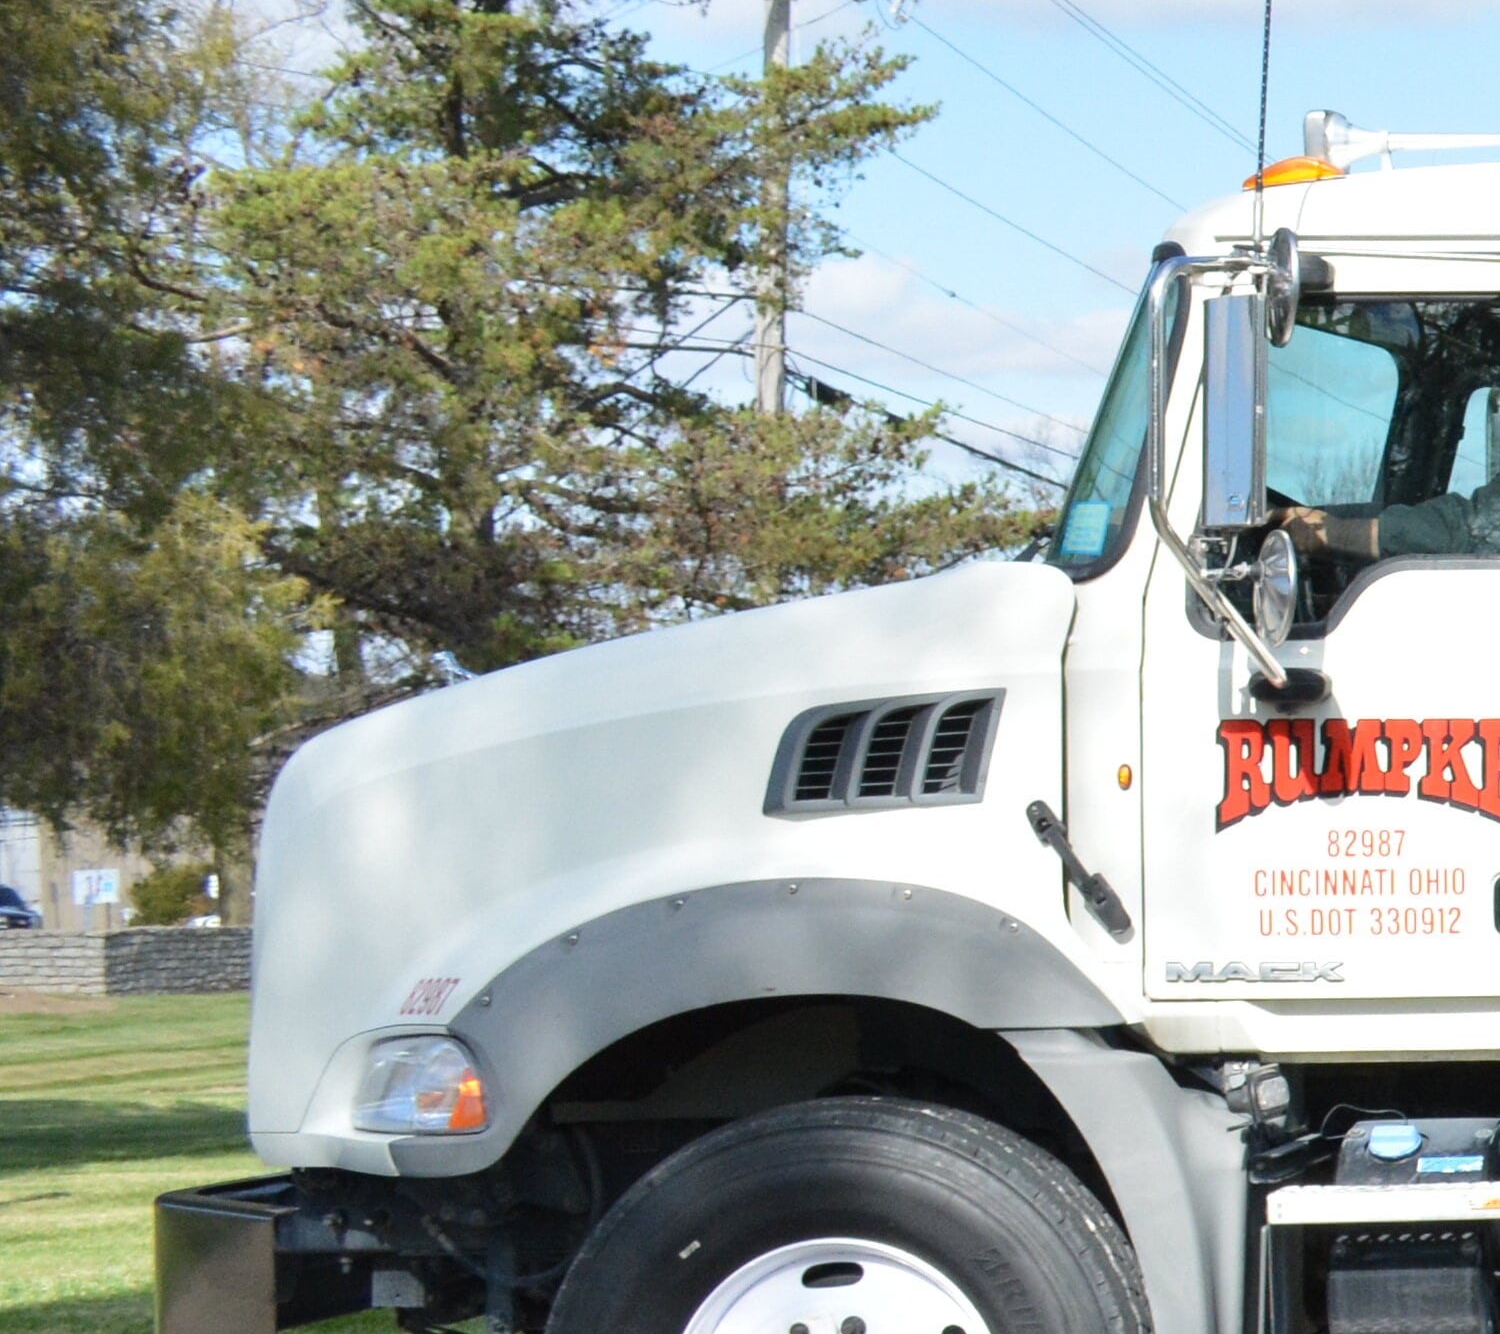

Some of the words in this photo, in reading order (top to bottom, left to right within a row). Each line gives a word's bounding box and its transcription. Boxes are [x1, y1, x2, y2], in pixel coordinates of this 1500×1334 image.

[1327, 829, 1406, 857] 82987
[1254, 868, 1395, 897] CINCINNATI
[1409, 867, 1466, 896] OHIO
[1259, 908, 1357, 937] U.S.DOT
[1370, 906, 1462, 935] 330912
[1165, 961, 1345, 983] MACK
